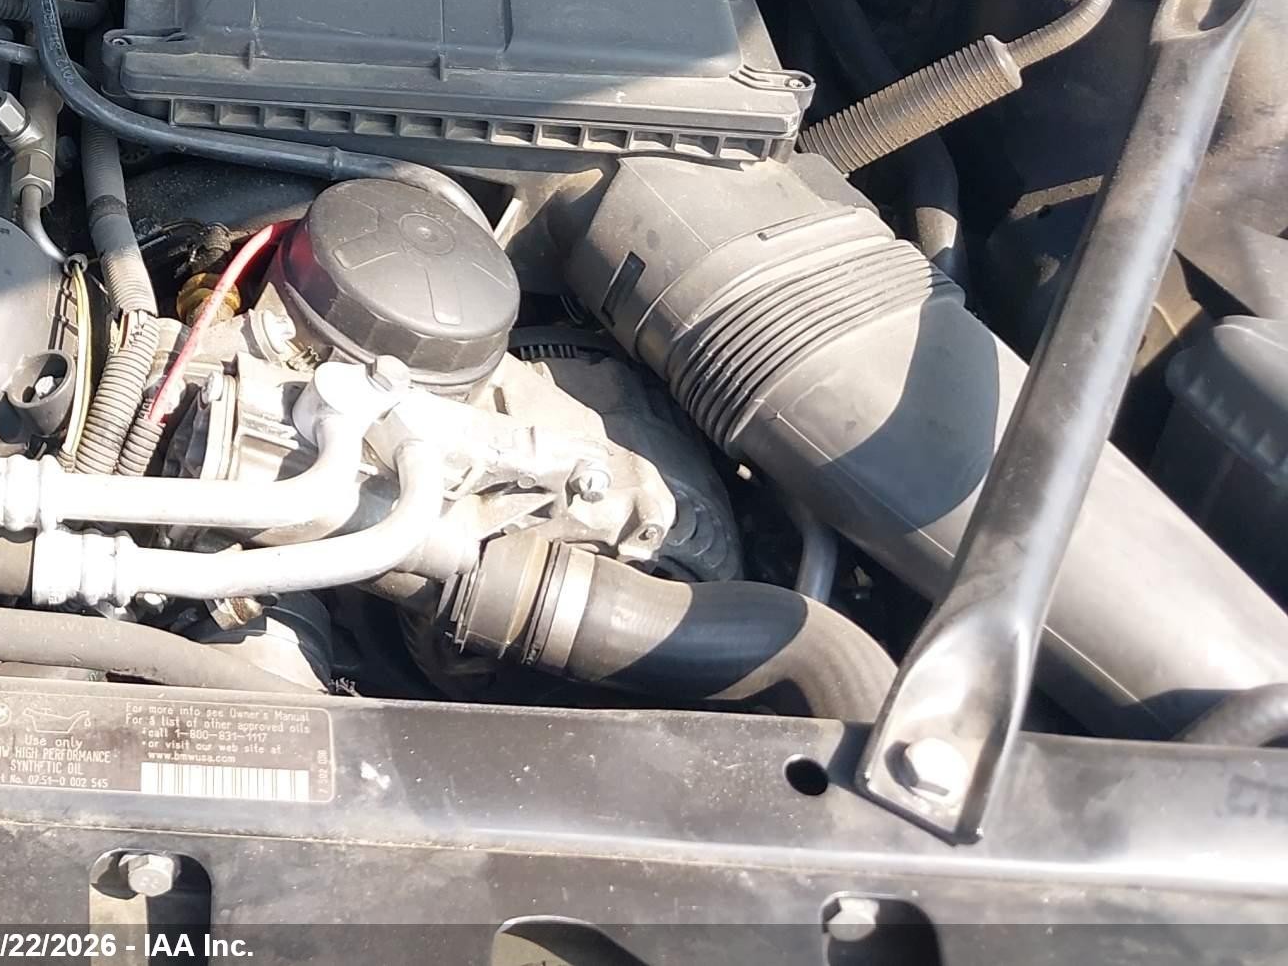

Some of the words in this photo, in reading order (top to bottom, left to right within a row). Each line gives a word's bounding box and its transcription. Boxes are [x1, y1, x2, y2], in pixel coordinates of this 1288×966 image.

[125, 702, 142, 714] For
[148, 705, 174, 715] more
[179, 704, 201, 716] info
[206, 708, 223, 717] see
[274, 710, 310, 722] Manual
[125, 714, 143, 725] For
[161, 716, 180, 728] list
[186, 718, 198, 729] of
[204, 719, 232, 731] other
[237, 721, 284, 733] approved
[289, 723, 310, 734] oils
[24, 735, 47, 746] Use
[55, 736, 84, 750] only
[165, 740, 190, 751] visit
[195, 743, 213, 752] our
[218, 742, 238, 753] web
[244, 743, 265, 754] site
[270, 745, 282, 755] at
[15, 746, 39, 759] HIGH
[42, 748, 111, 764] PERFORMANCE
[147, 751, 237, 764] www.bmwusa.com
[67, 763, 85, 775] OIL
[70, 777, 87, 787] 002
[90, 778, 109, 788] 545
